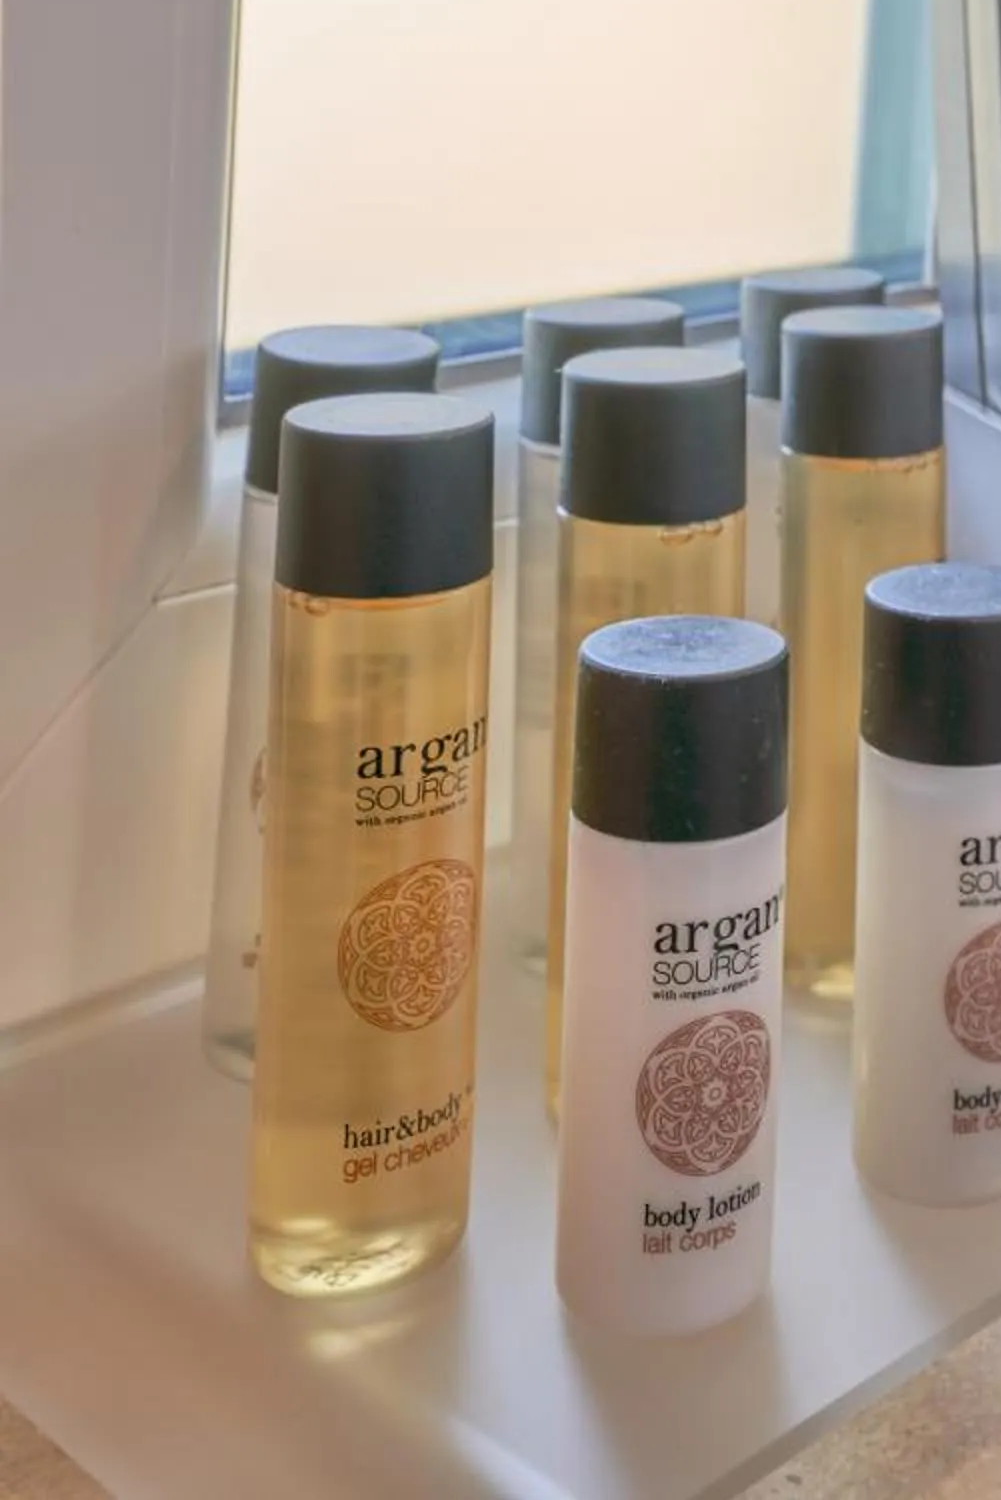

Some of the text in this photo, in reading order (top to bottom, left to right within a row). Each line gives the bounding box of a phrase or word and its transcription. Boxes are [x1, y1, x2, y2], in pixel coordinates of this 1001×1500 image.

[356, 717, 487, 780] argan
[355, 763, 470, 813] SOURCE
[653, 893, 781, 956] argan
[652, 942, 762, 986] SOURCE
[342, 1150, 378, 1185] gel
[643, 1181, 761, 1234] body lotion
[642, 1219, 738, 1254] lait corps
